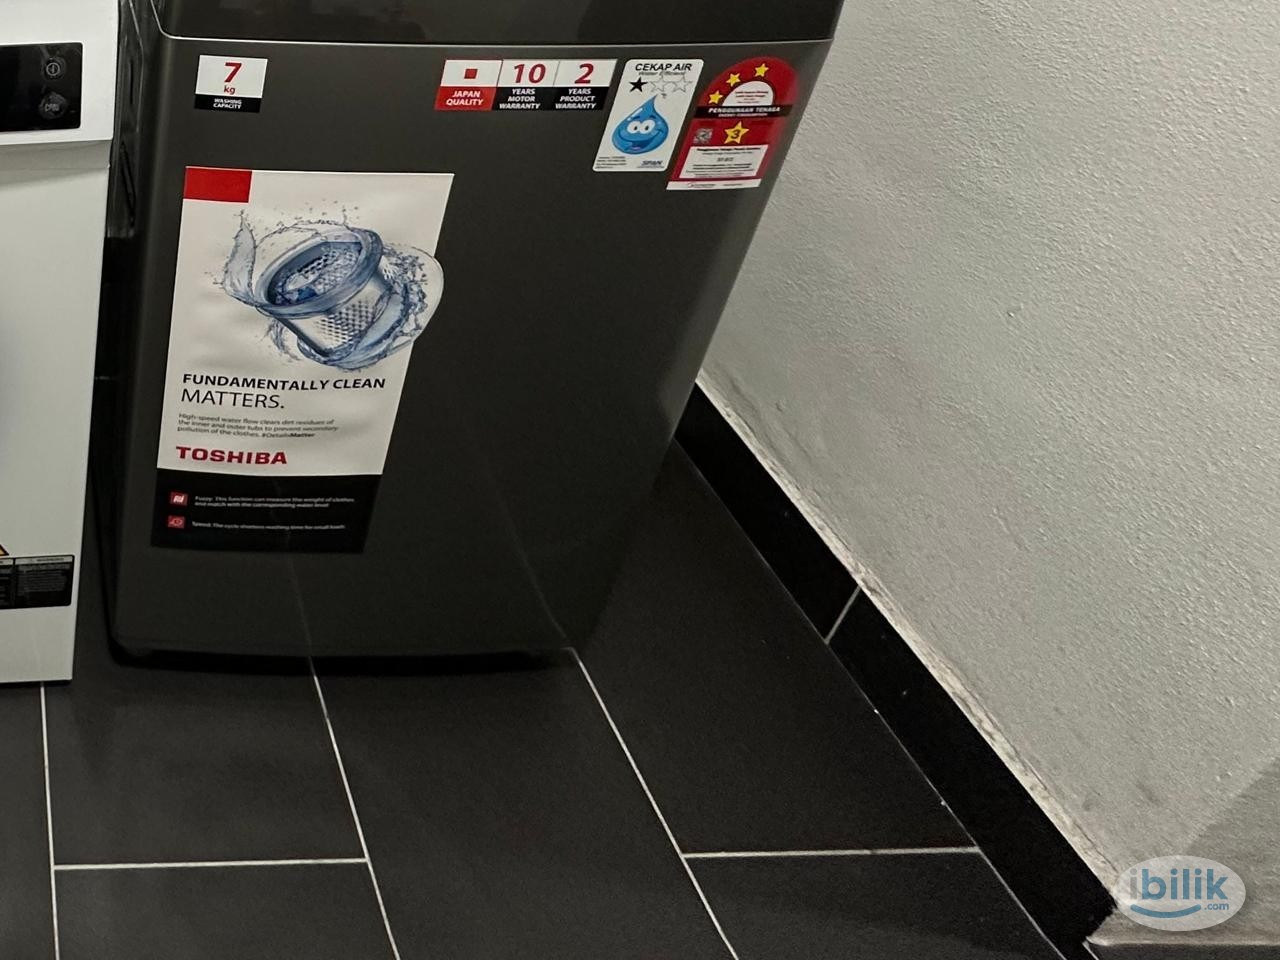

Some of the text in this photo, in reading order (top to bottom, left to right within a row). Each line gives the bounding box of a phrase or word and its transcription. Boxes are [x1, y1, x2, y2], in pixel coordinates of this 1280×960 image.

[635, 63, 693, 71] CEKAP AIR
[224, 62, 242, 83] 7
[514, 63, 546, 84] 10
[574, 63, 594, 84] 2
[223, 85, 235, 95] kg
[452, 90, 481, 98] JAPAN
[213, 102, 241, 110] CAPACITY
[446, 98, 484, 106] QUALITY
[731, 129, 740, 139] 3
[182, 373, 386, 391] FUNDAMENTALLY CLEAN
[181, 389, 285, 409] MATTERS.
[178, 413, 220, 421] High-speed
[176, 446, 287, 465] TOSHIBA
